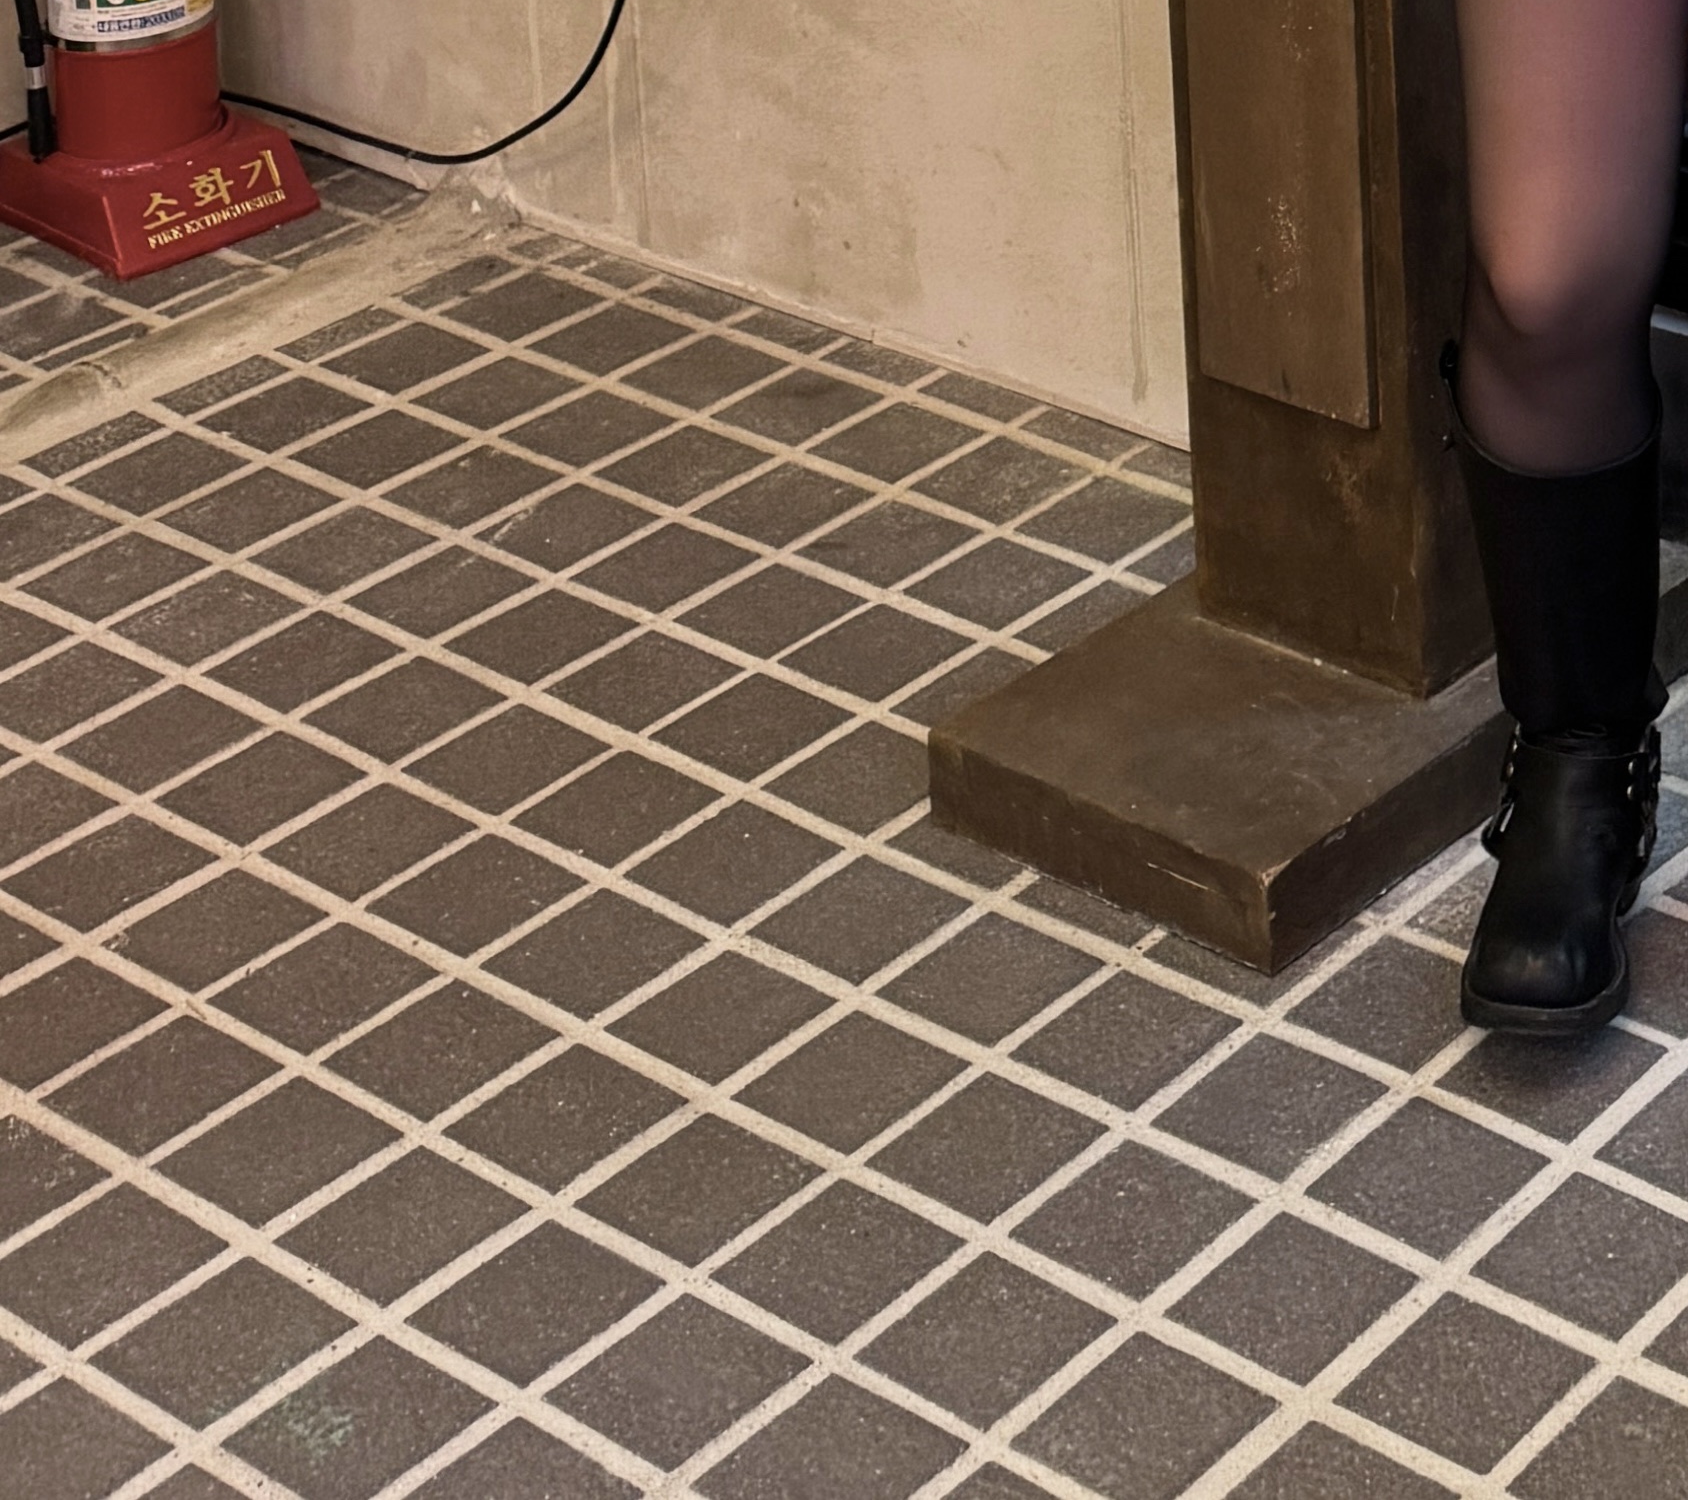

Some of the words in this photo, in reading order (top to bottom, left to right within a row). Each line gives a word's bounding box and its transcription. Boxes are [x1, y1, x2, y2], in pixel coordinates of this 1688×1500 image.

[143, 149, 282, 230] 소화기
[148, 225, 183, 249] FIRE
[184, 188, 287, 235] EXTINGUISHER
